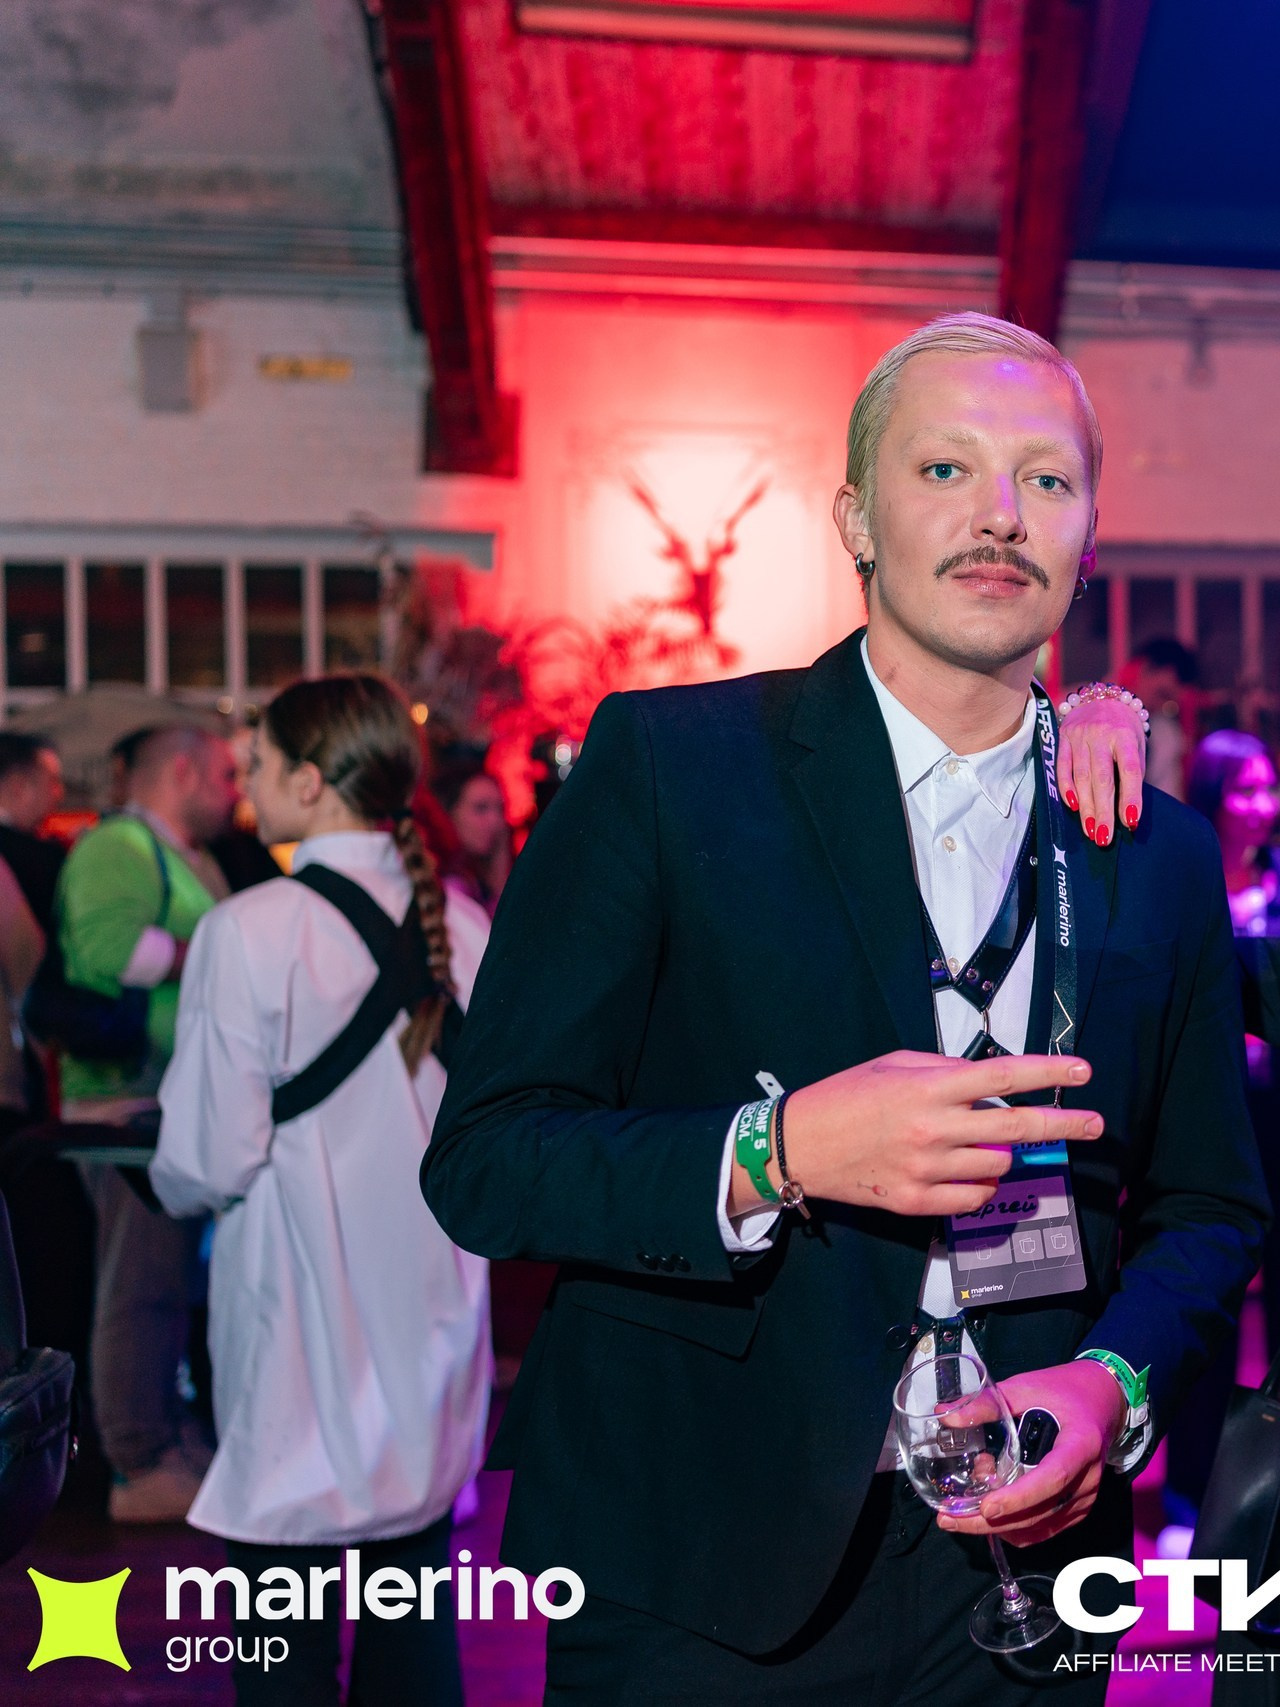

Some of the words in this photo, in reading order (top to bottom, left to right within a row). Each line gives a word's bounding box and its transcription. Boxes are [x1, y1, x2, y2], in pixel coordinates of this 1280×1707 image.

[1057, 868, 1071, 947] marlerino
[754, 1099, 773, 1133] CONF
[754, 1138, 767, 1150] 5
[970, 1284, 1004, 1295] marlerino
